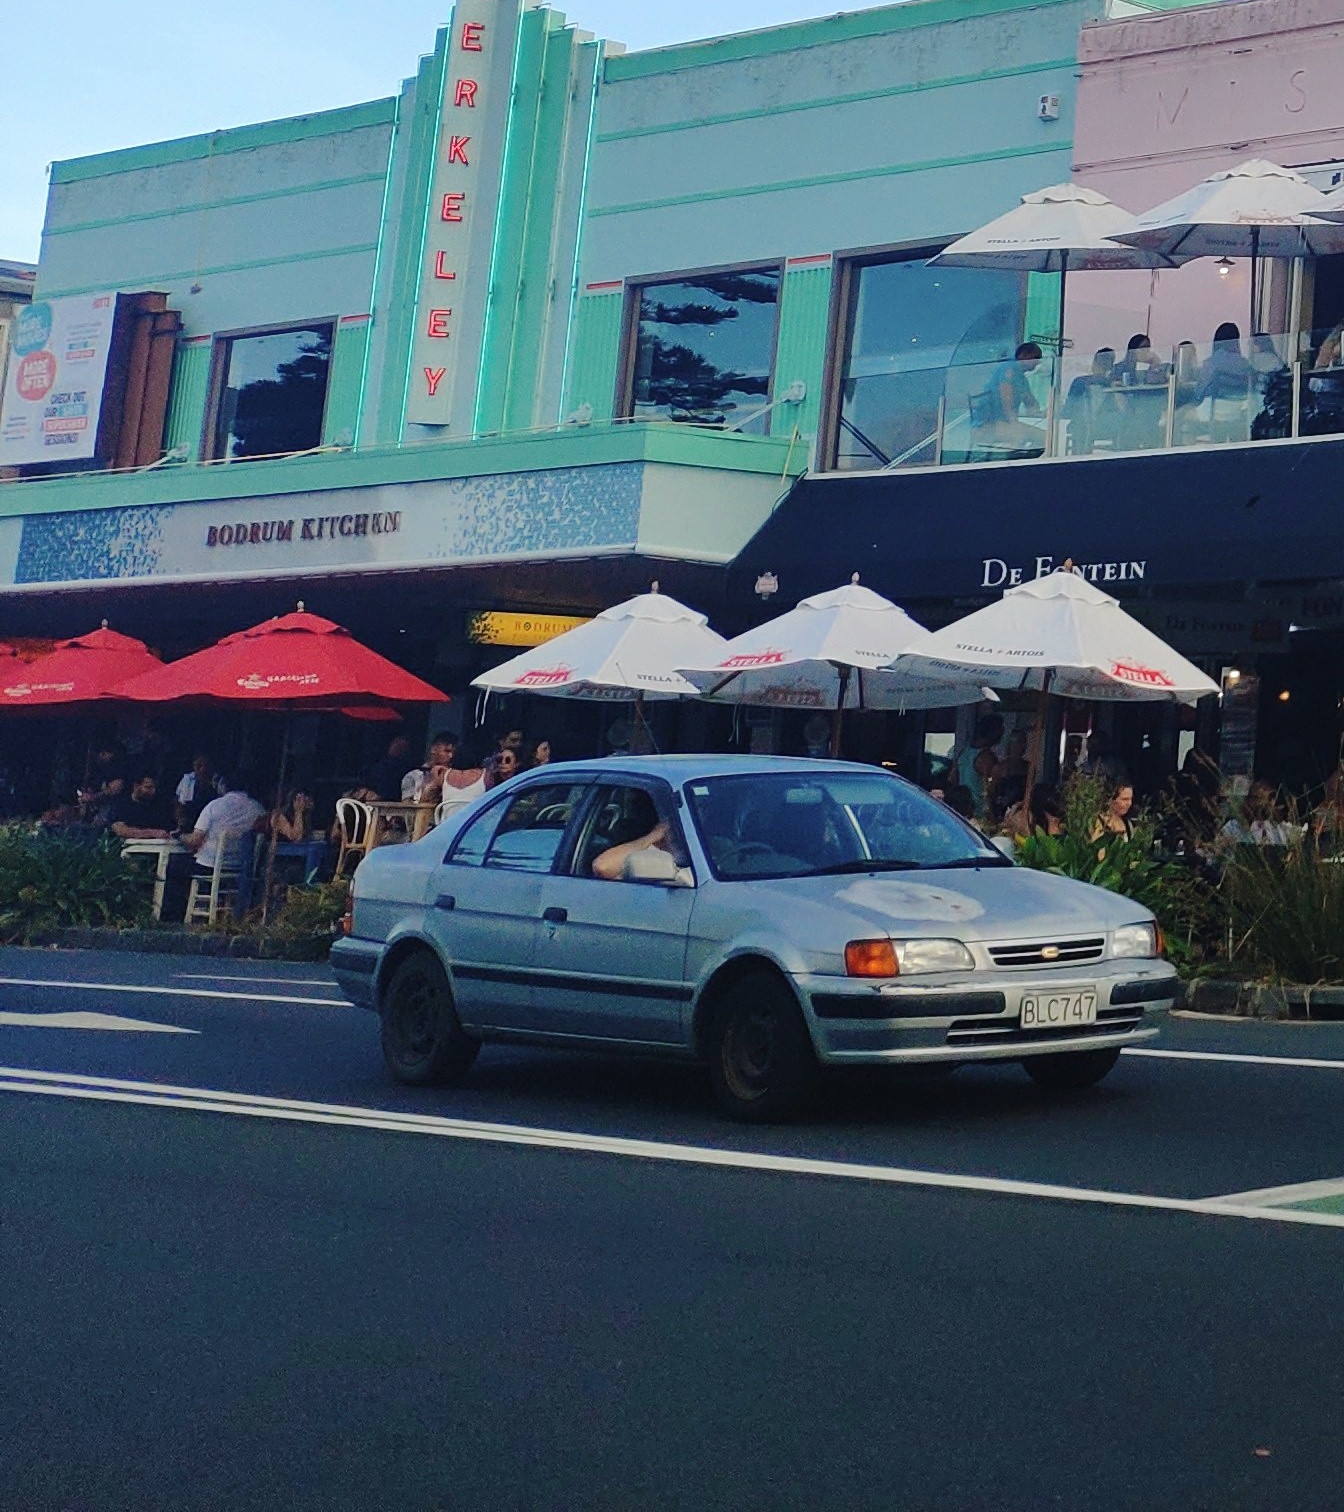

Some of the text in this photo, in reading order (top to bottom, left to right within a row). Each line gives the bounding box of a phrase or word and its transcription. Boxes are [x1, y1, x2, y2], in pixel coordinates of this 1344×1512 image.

[205, 519, 295, 548] BODRUM
[955, 643, 1045, 657] STELLA ARTOIS
[637, 674, 672, 683] STELLA
[1118, 667, 1166, 686] STELLA
[1023, 995, 1095, 1024] BLC747
